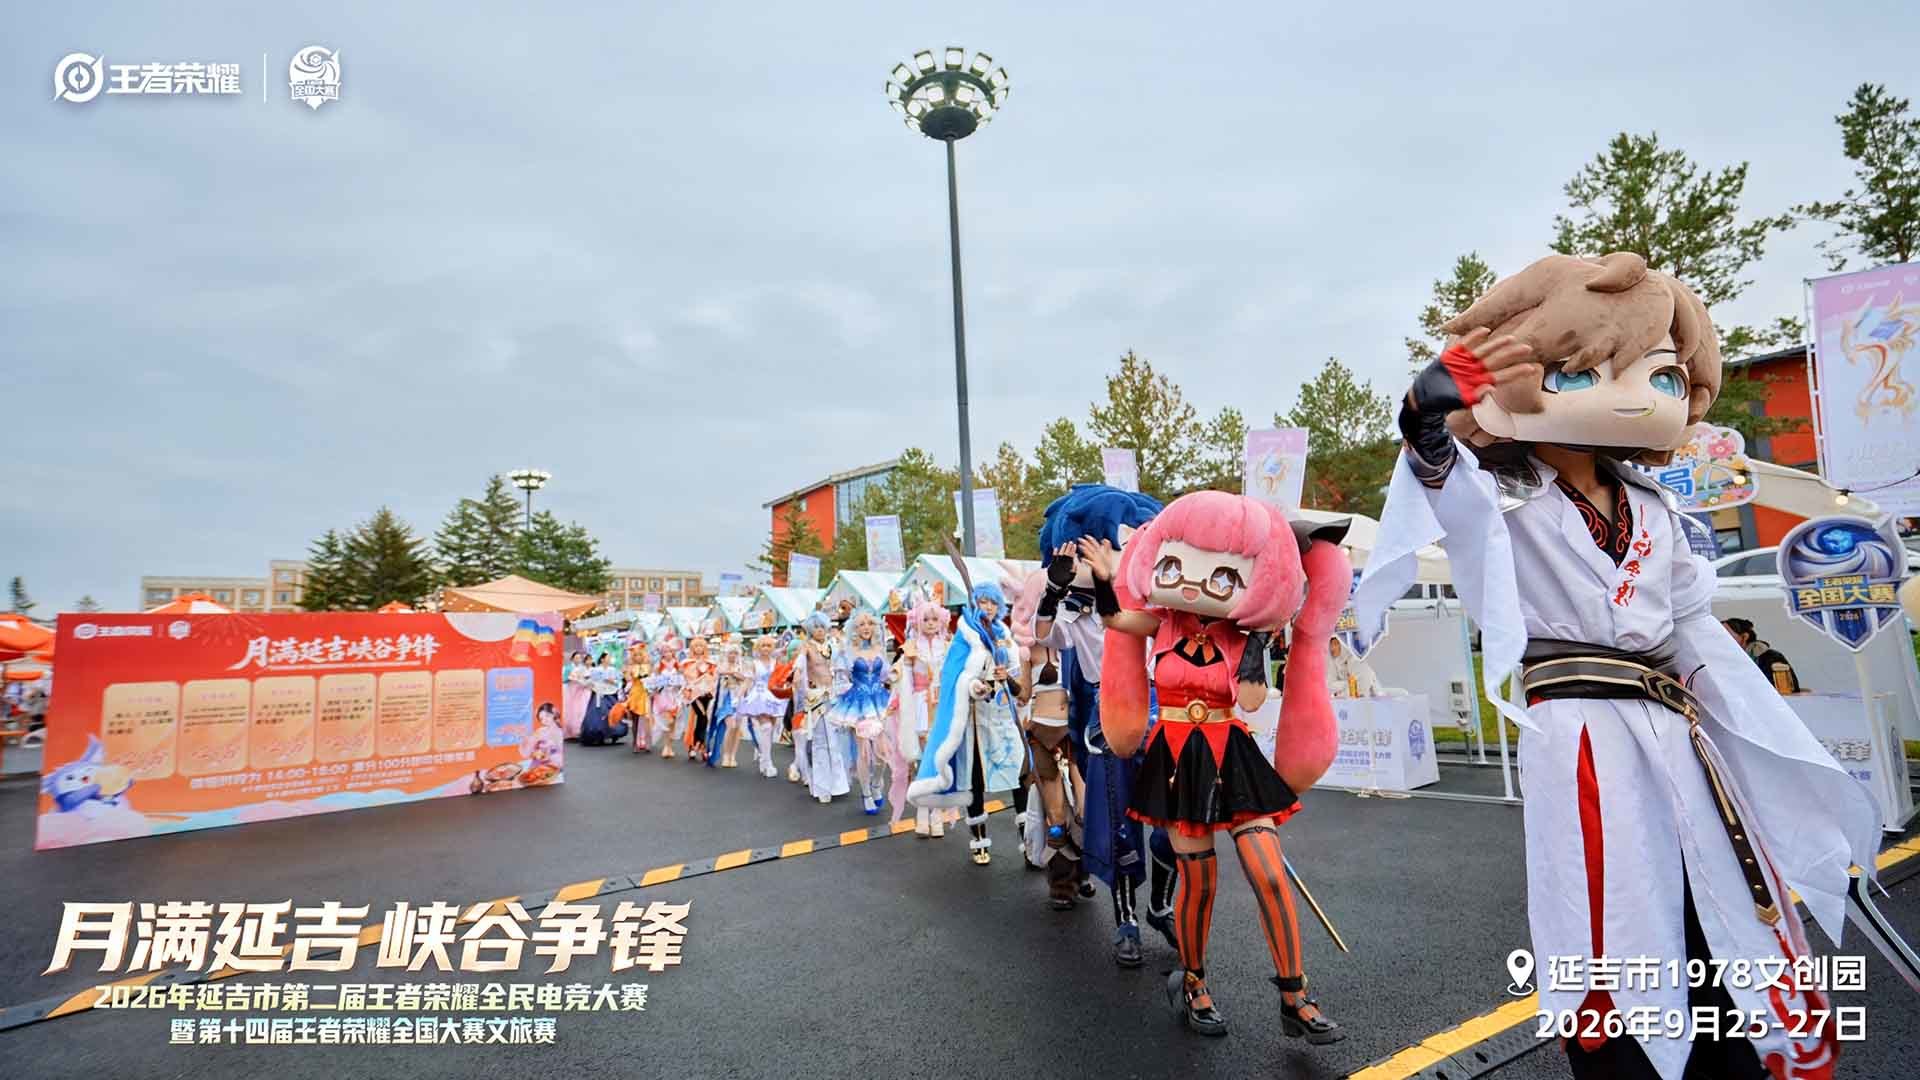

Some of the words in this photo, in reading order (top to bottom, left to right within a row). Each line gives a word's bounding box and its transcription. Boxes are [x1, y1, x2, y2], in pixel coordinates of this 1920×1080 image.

[1798, 583, 1896, 609] 全国大赛
[226, 633, 441, 671] 月满延吉峡谷争锋
